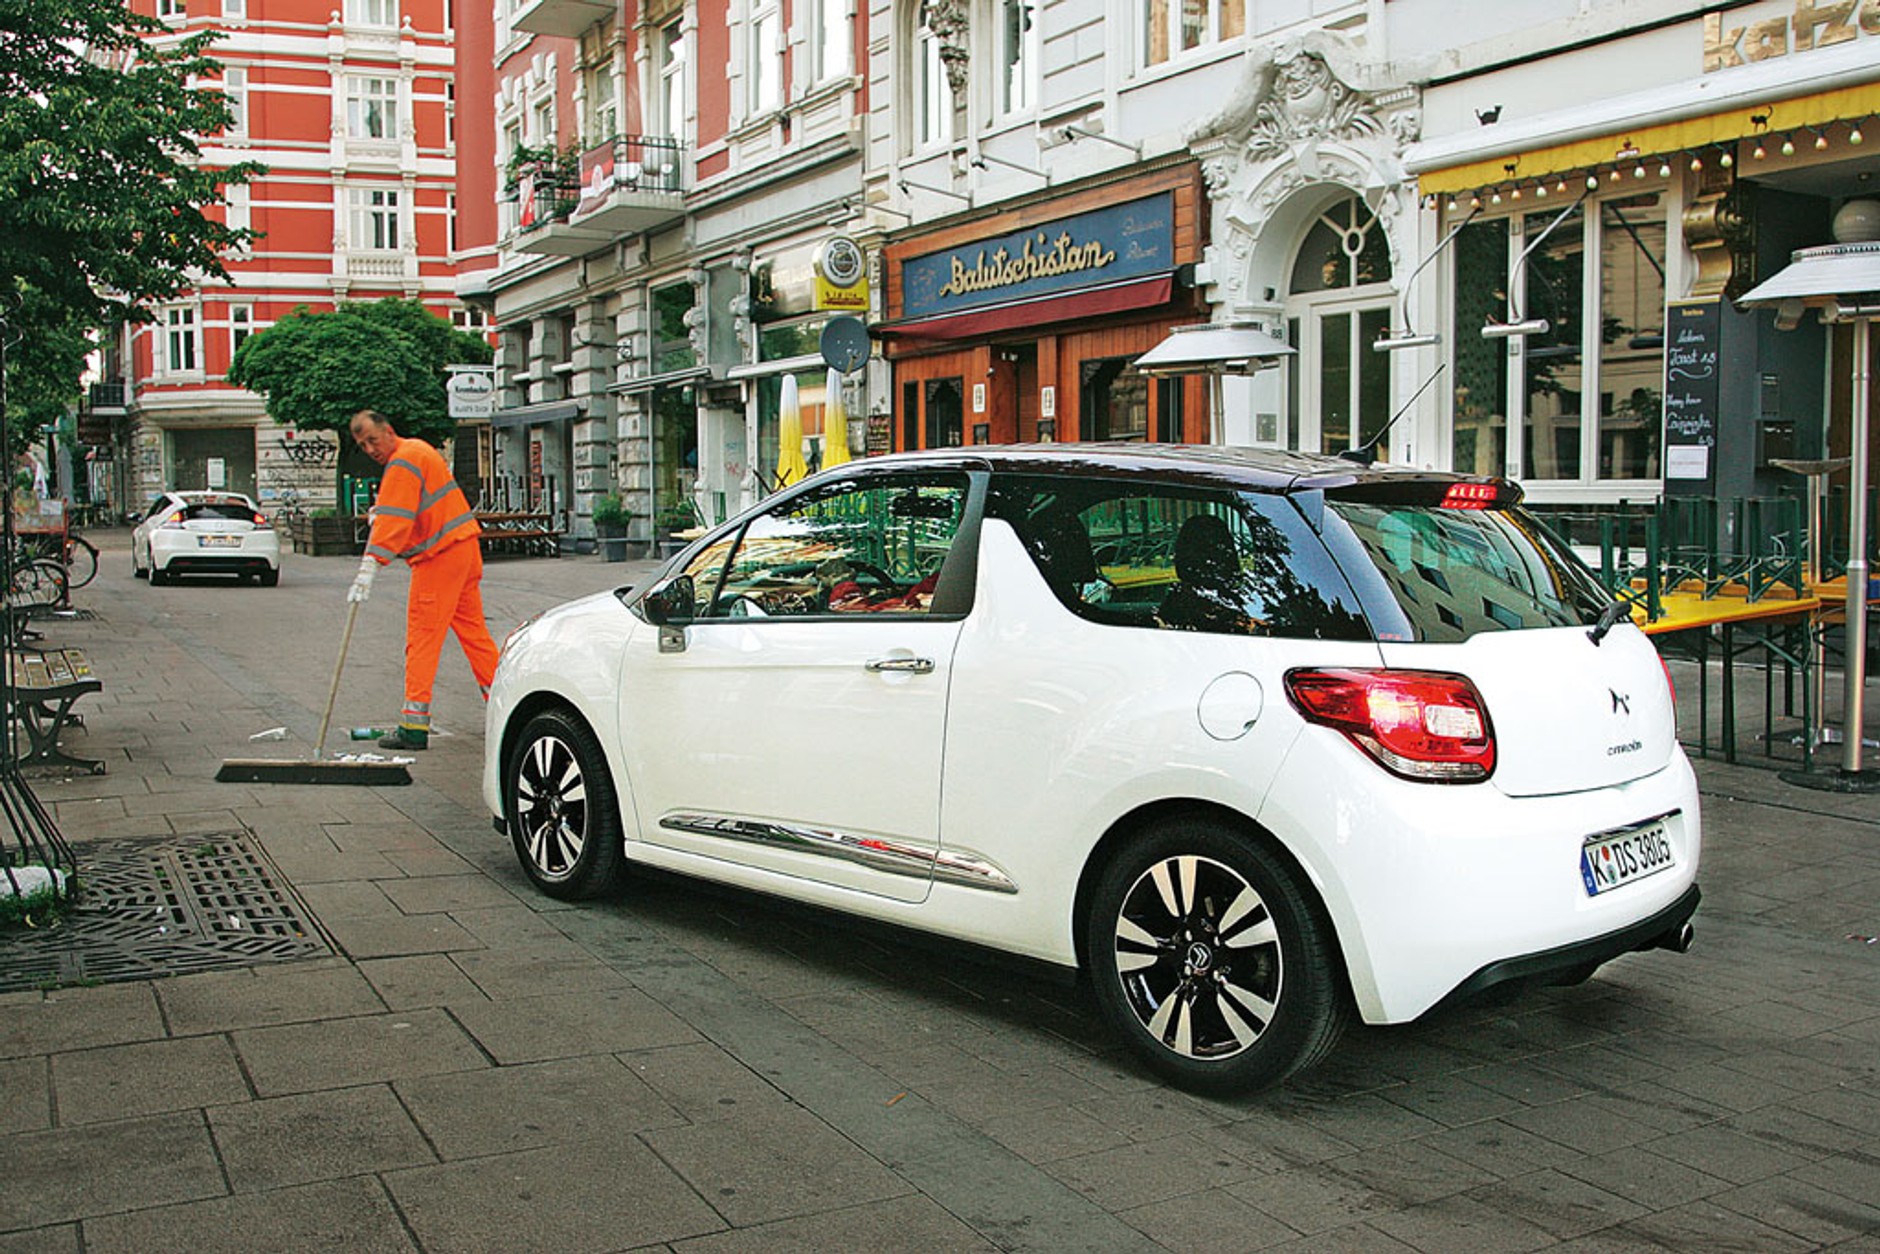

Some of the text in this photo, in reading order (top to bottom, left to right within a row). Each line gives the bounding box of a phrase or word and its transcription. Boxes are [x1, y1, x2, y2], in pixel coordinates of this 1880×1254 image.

[939, 231, 1115, 297] Balutschistan
[1589, 849, 1609, 886] K
[1611, 840, 1638, 878] DS
